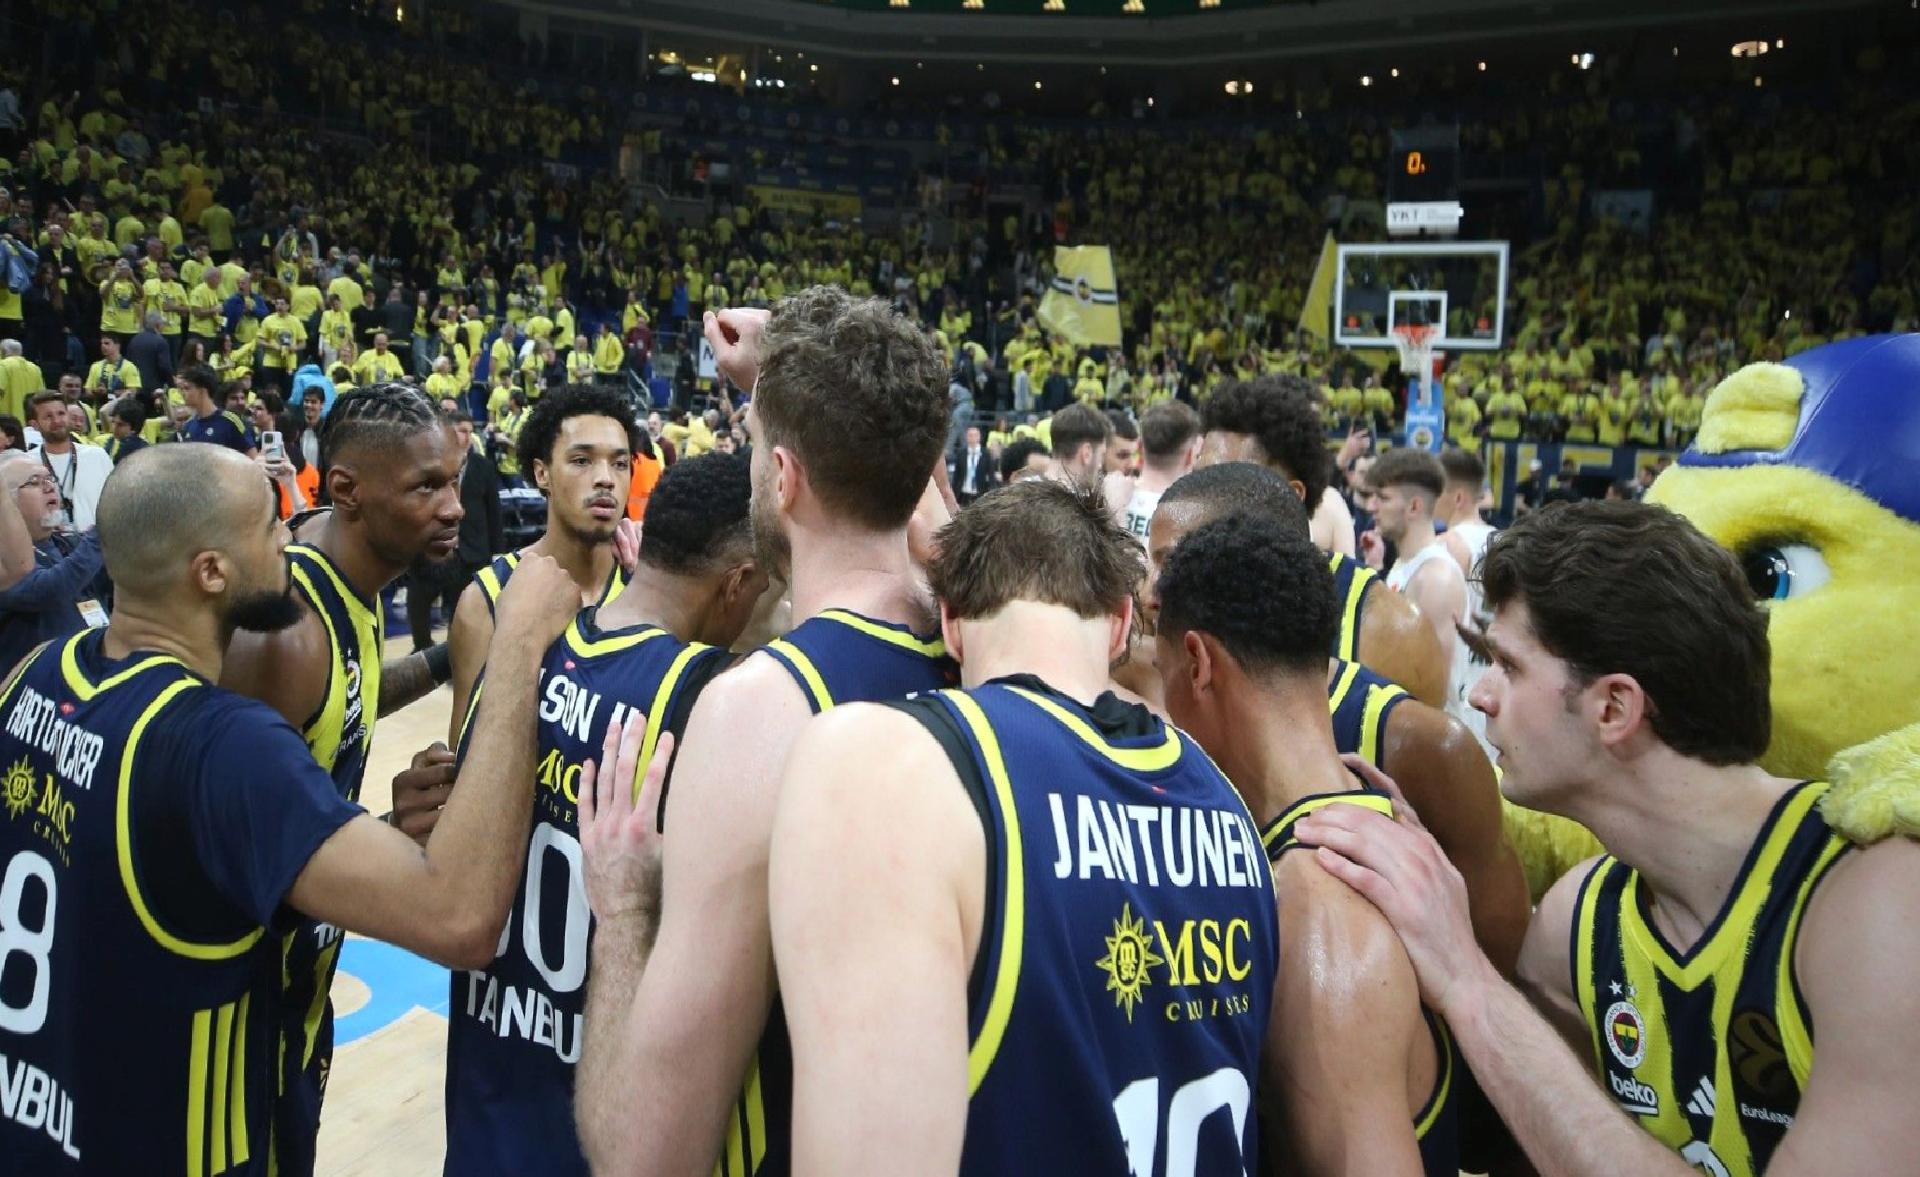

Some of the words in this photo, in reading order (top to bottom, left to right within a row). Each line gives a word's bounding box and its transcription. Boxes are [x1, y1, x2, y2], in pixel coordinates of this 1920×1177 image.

[1048, 792, 1263, 889] JANTUNEN
[1152, 917, 1252, 987] MSC
[1165, 993, 1250, 1022] CRUISES
[1609, 1069, 1656, 1105] beko
